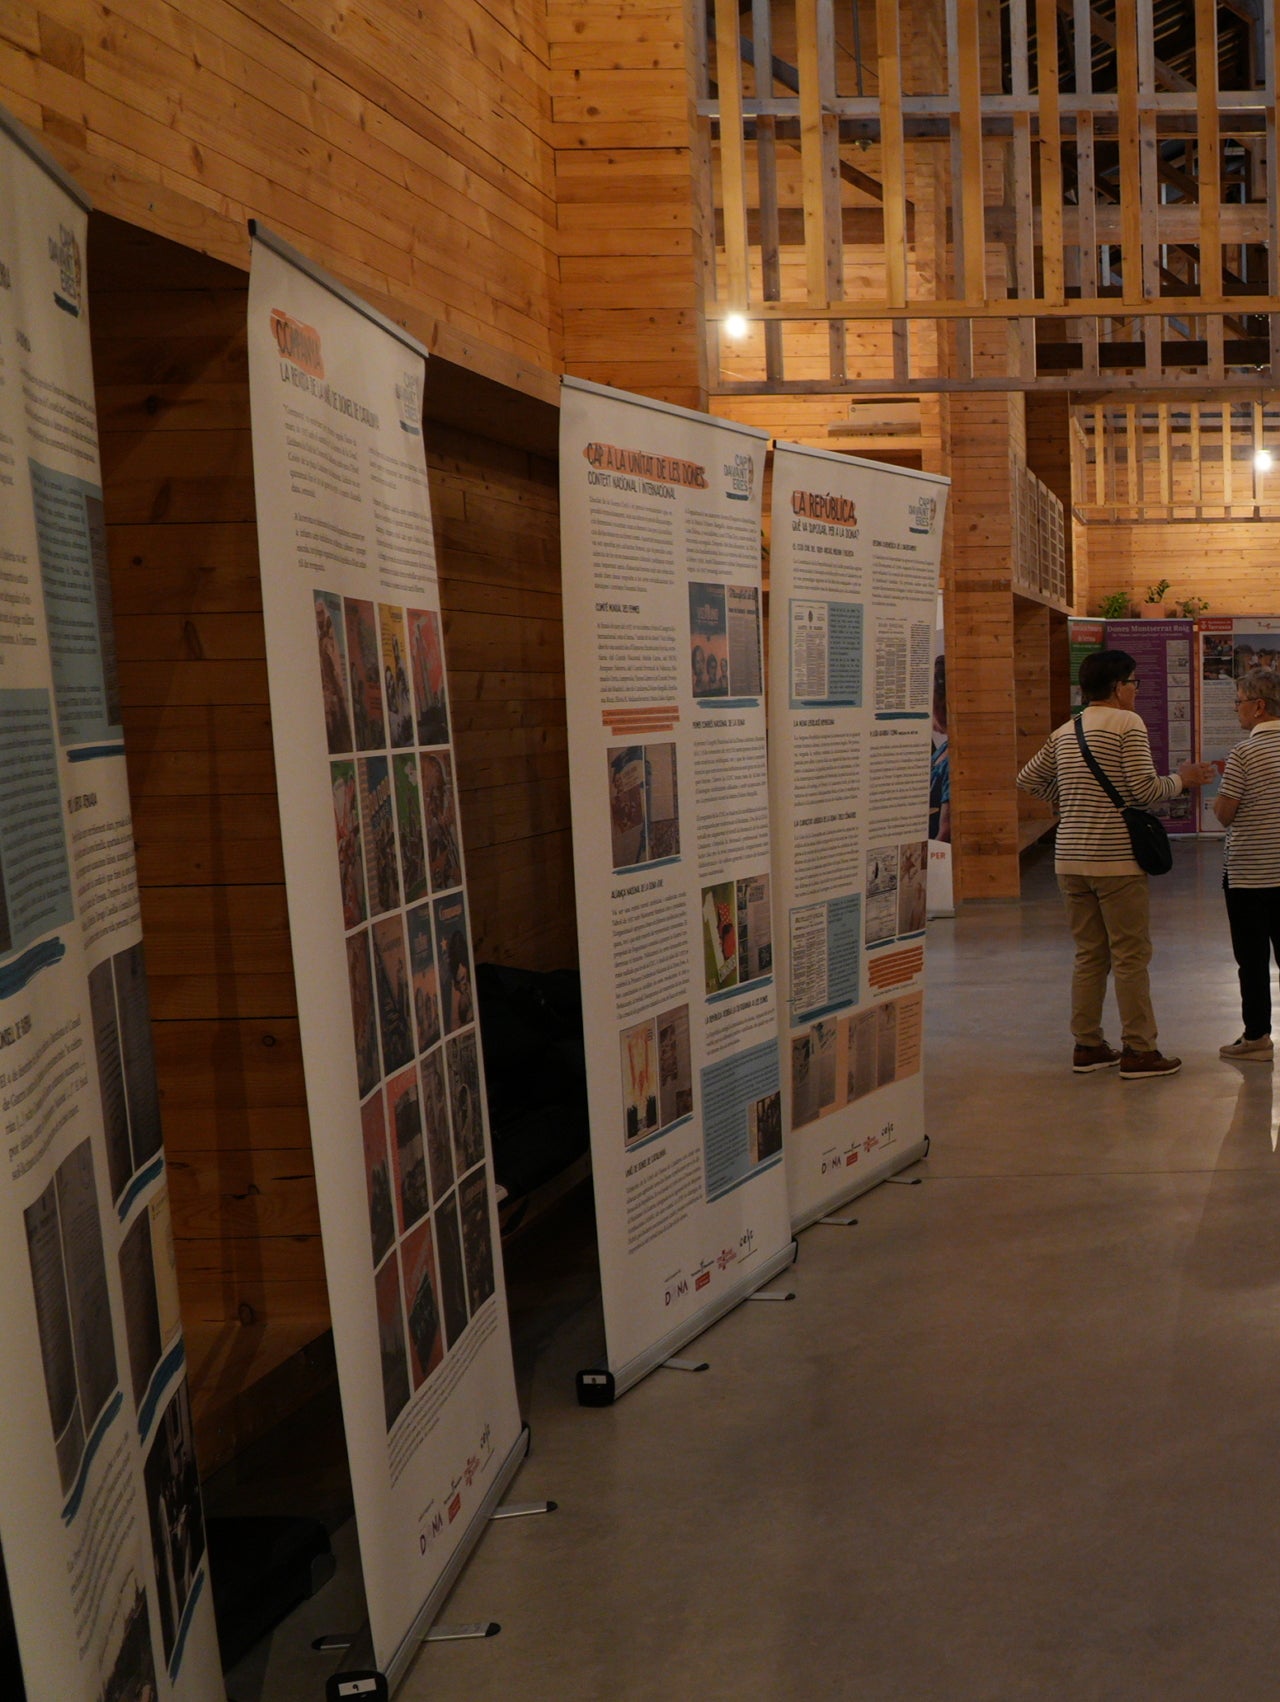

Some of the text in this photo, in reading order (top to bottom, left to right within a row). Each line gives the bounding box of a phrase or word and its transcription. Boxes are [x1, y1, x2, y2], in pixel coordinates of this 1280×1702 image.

[615, 448, 626, 470] LA
[792, 490, 806, 514] LA
[665, 1280, 688, 1306] DNA
